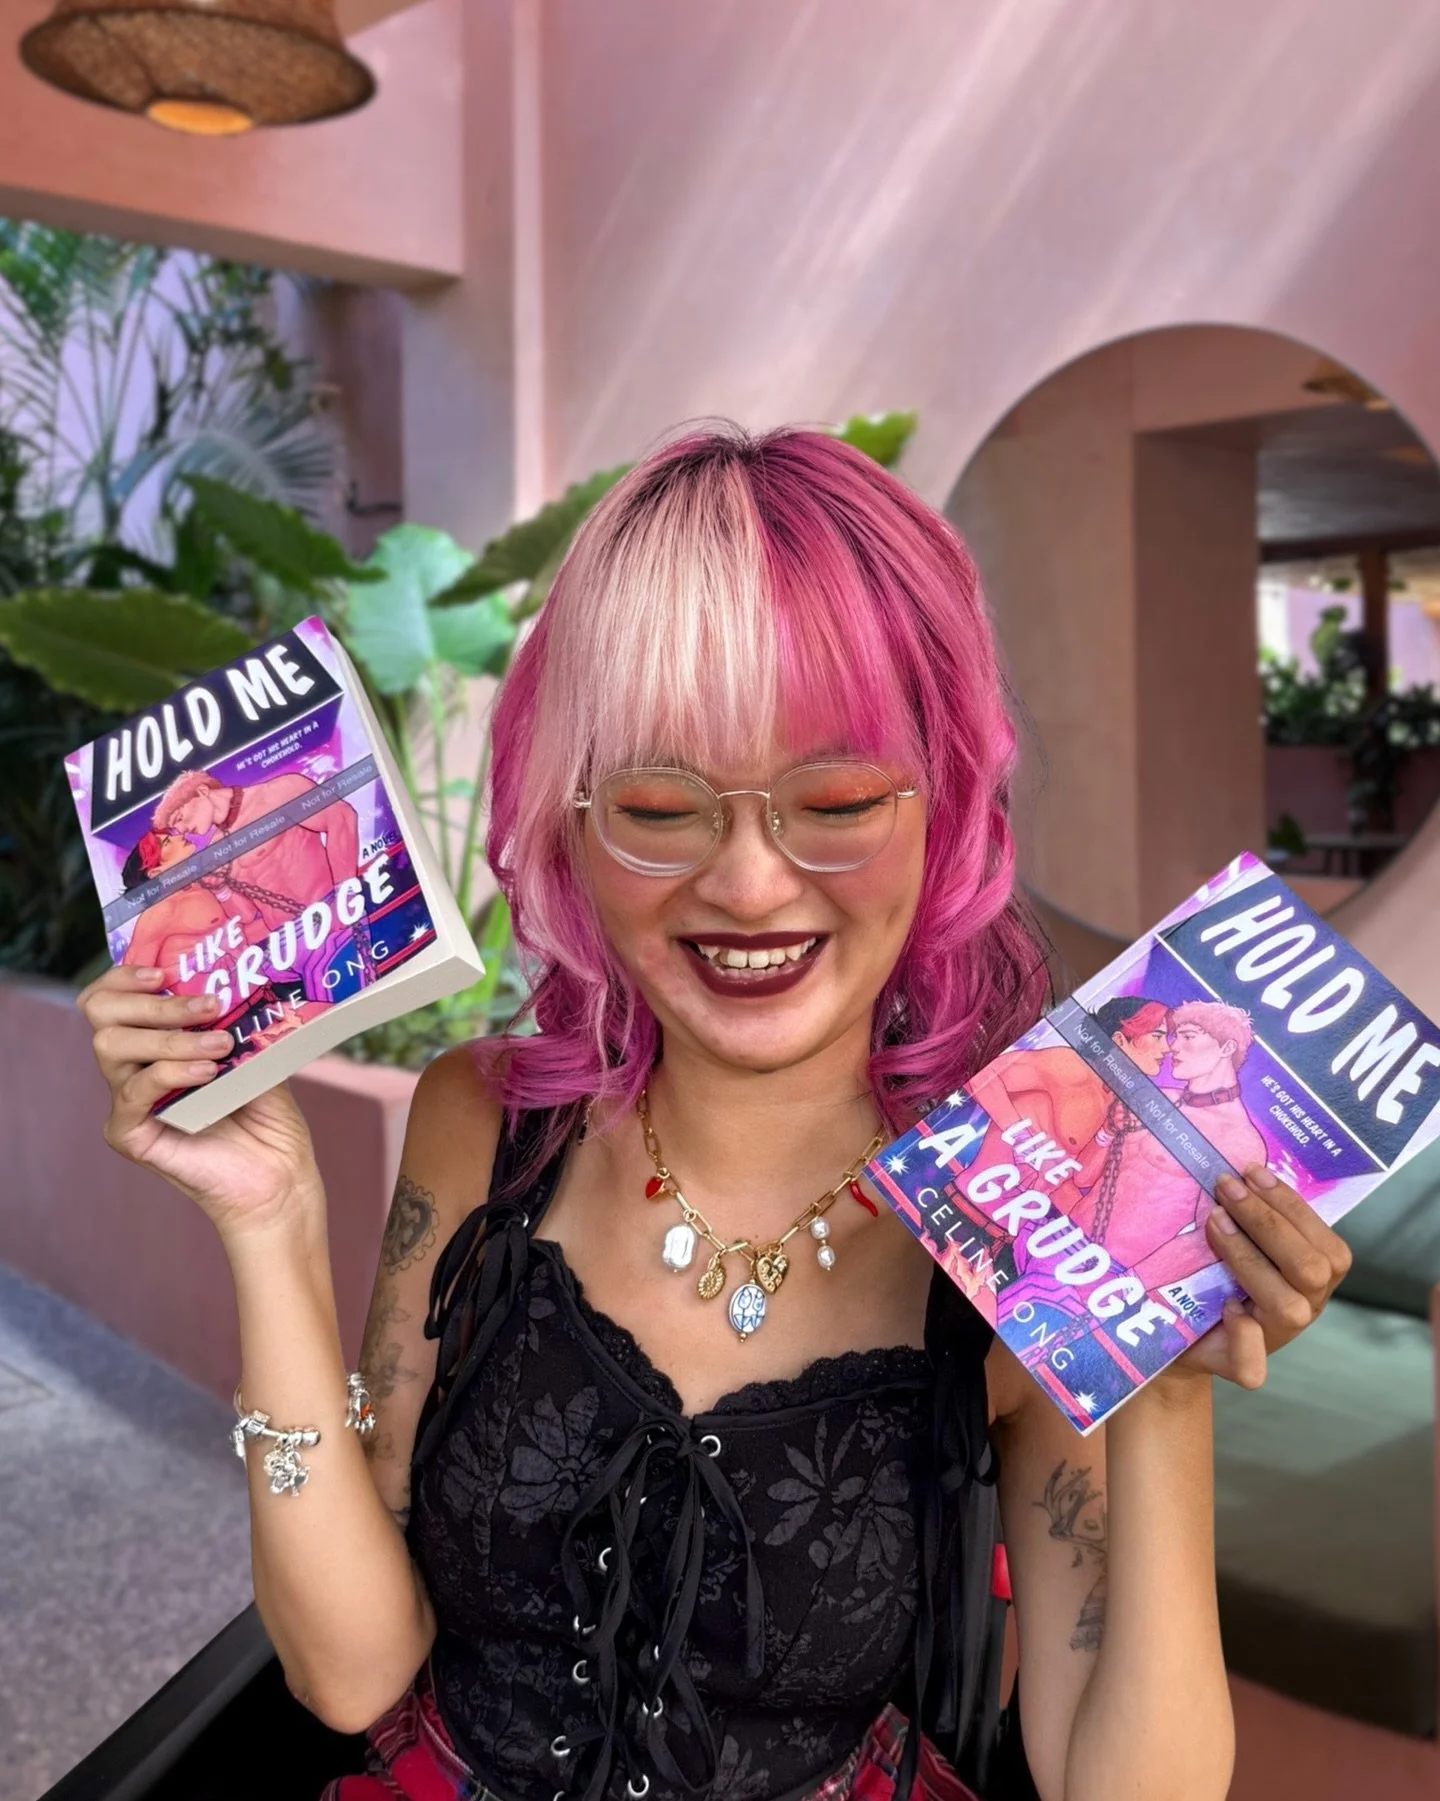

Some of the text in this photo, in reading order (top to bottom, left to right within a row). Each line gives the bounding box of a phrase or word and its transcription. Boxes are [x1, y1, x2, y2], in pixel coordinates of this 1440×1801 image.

[106, 644, 315, 801] HOLD ME
[312, 720, 319, 730] A
[127, 764, 373, 909] Not for Resale Not for Resale Not for Resale
[362, 848, 370, 859] A
[178, 915, 244, 983] LIKE
[204, 853, 395, 1018] GRUDGE
[235, 940, 389, 1043] LINE ONG
[1200, 895, 1440, 1125] HOLD ME
[1073, 1023, 1210, 1169] Not for Resale Not for Resale
[1260, 1074, 1342, 1157] HE'S GOT HIS HEART IN A
[1269, 1104, 1311, 1148] CHOKEHOLD.
[1001, 1117, 1083, 1186] LIKE
[917, 1187, 1074, 1371] CELINE ONG
[918, 1123, 1176, 1347] A GRUDGE
[1168, 1286, 1207, 1322] A NOVE
